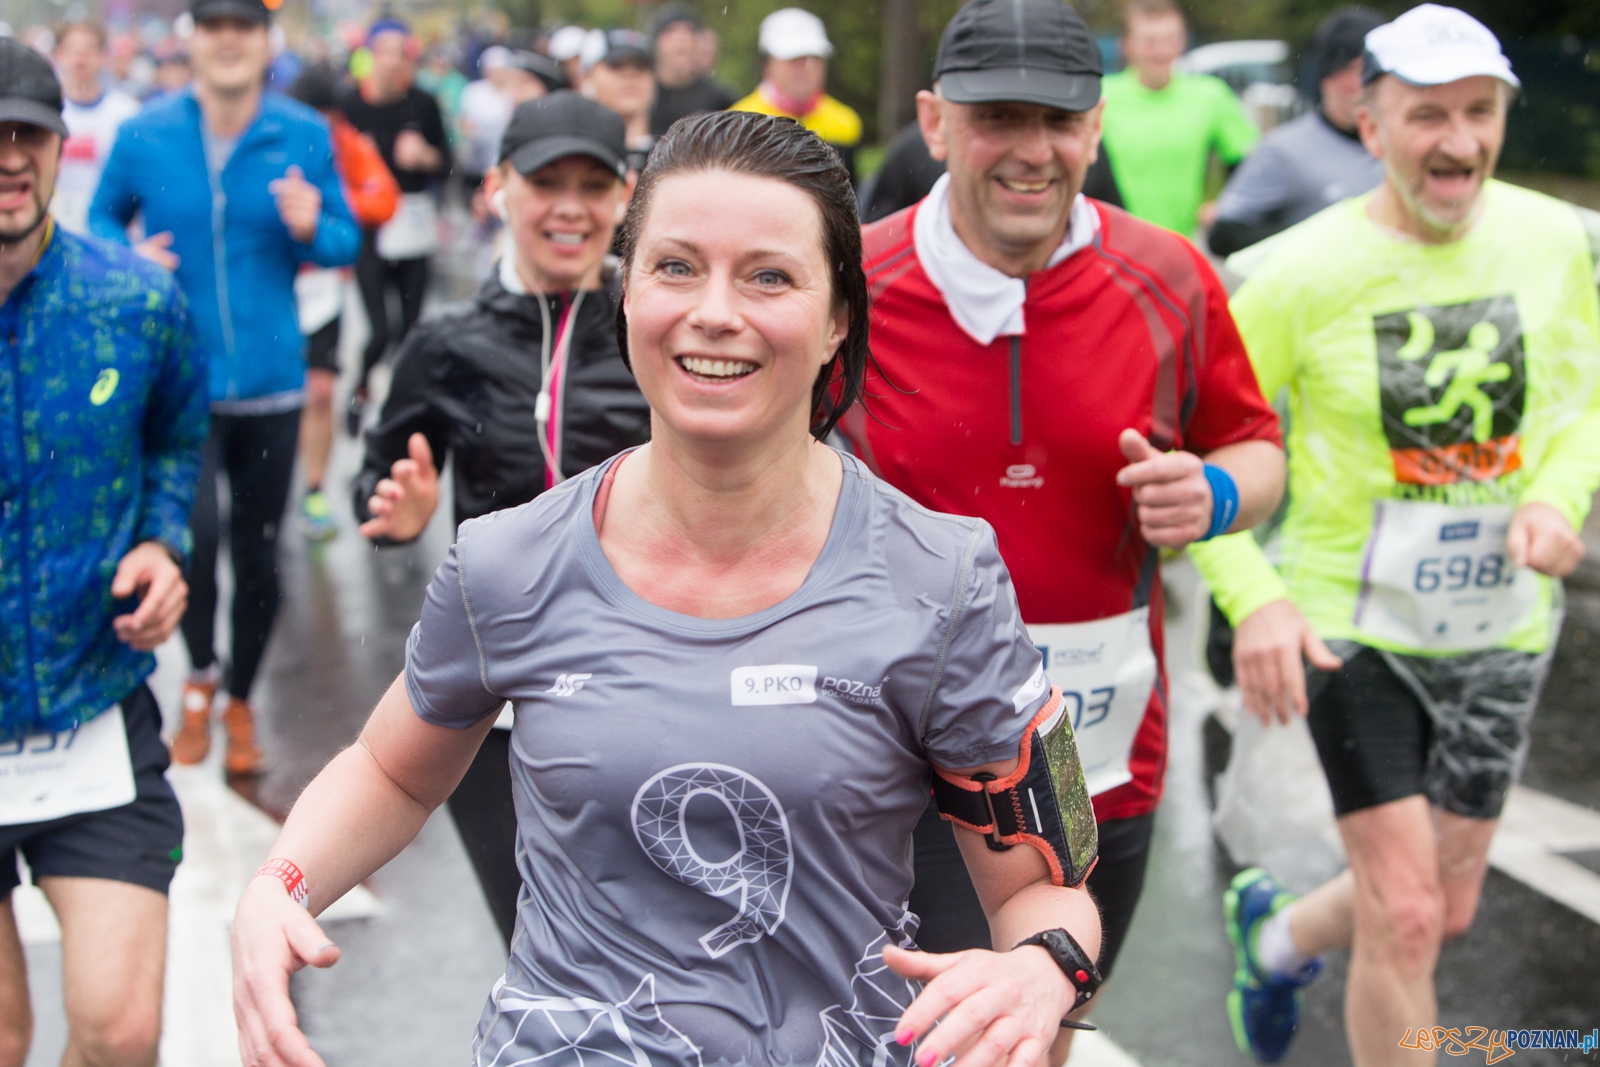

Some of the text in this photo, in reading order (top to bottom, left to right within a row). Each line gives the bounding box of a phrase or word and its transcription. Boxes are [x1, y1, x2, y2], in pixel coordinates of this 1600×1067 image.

[1414, 553, 1515, 594] 698
[763, 676, 803, 693] PKO
[630, 762, 794, 960] 9
